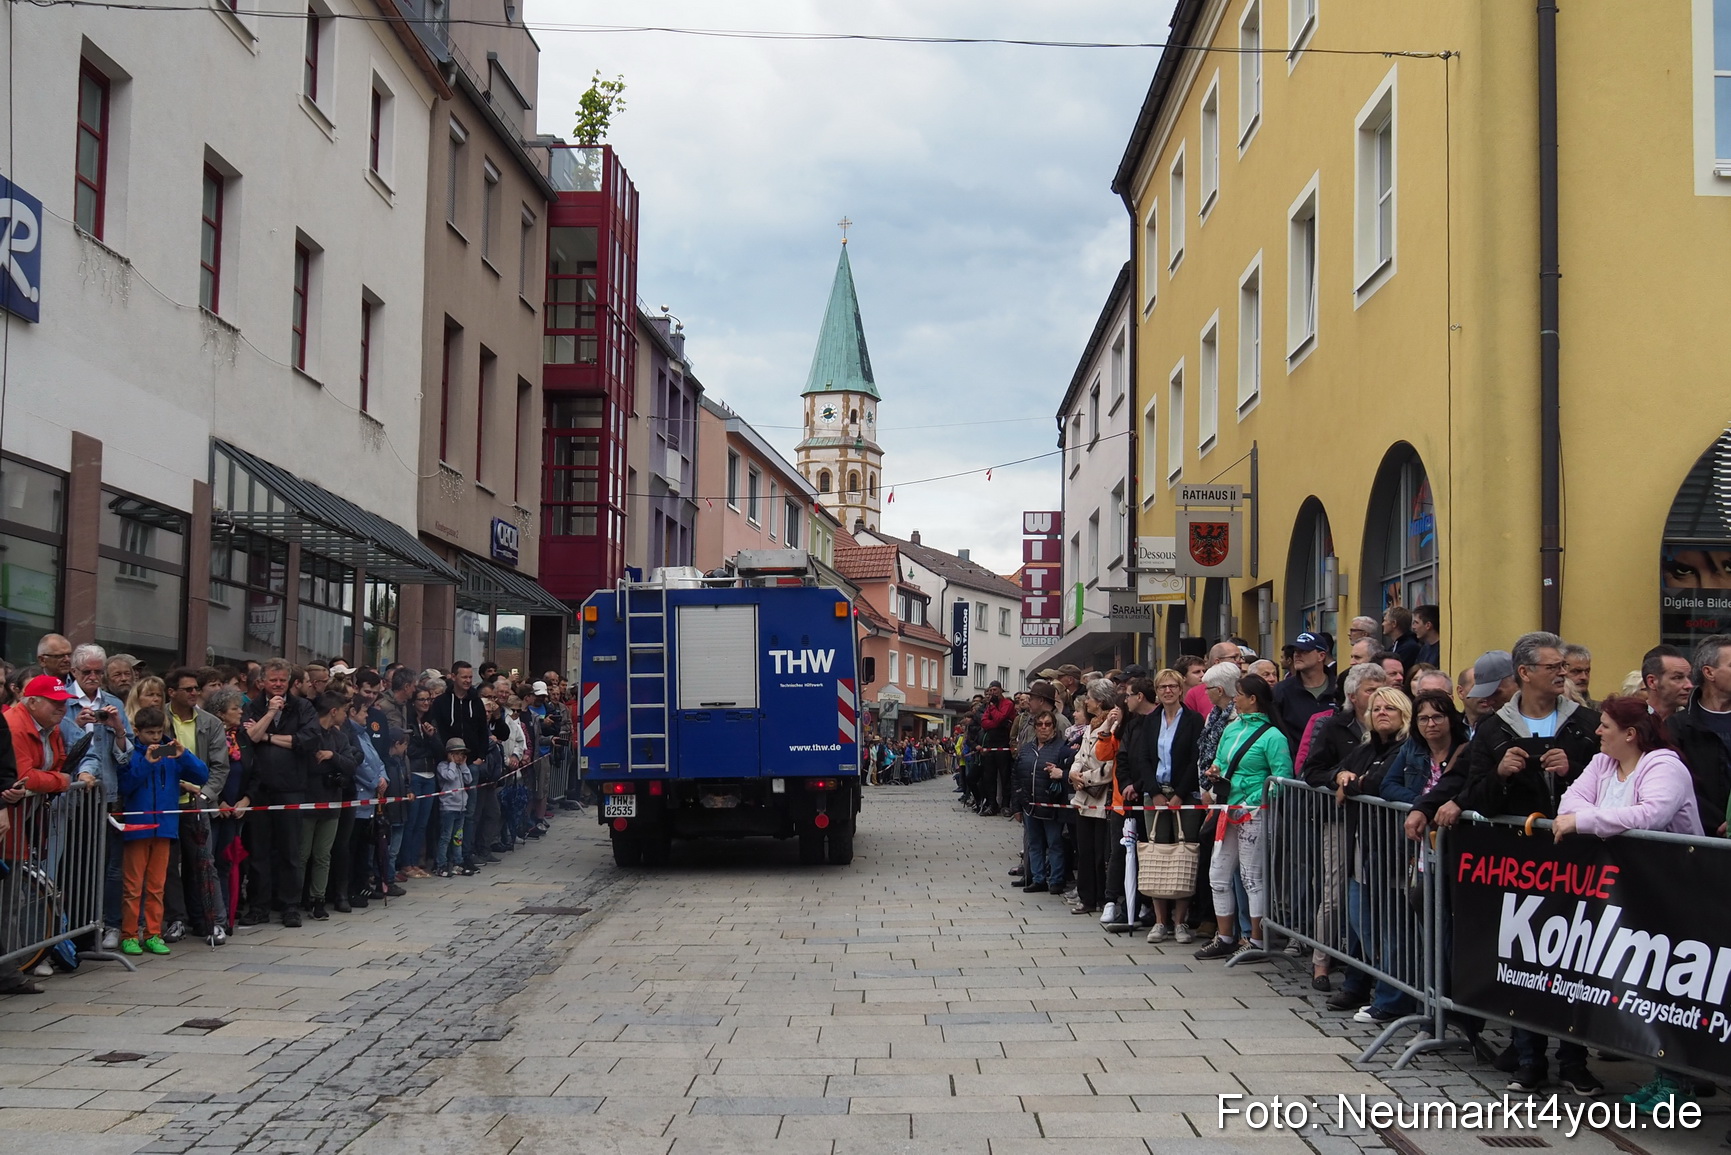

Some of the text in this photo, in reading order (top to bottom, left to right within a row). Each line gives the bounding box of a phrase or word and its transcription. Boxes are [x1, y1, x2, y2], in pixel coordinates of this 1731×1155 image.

[1182, 490, 1236, 500] RATHAUS II
[1139, 546, 1177, 560] Dessous
[1112, 604, 1151, 615] SARAH K
[1663, 597, 1704, 610] Digitale
[1685, 618, 1718, 628] sofort
[1022, 623, 1058, 636] WITT
[768, 649, 836, 674] THW
[789, 743, 842, 752] www.thw.de
[611, 796, 629, 806] THW
[606, 805, 633, 816] 82535
[1457, 852, 1621, 899] FAHRSCHULE
[1496, 962, 1549, 992] Neumarkt
[1550, 973, 1611, 1006] Burgthann
[1618, 989, 1701, 1031] Freystadt
